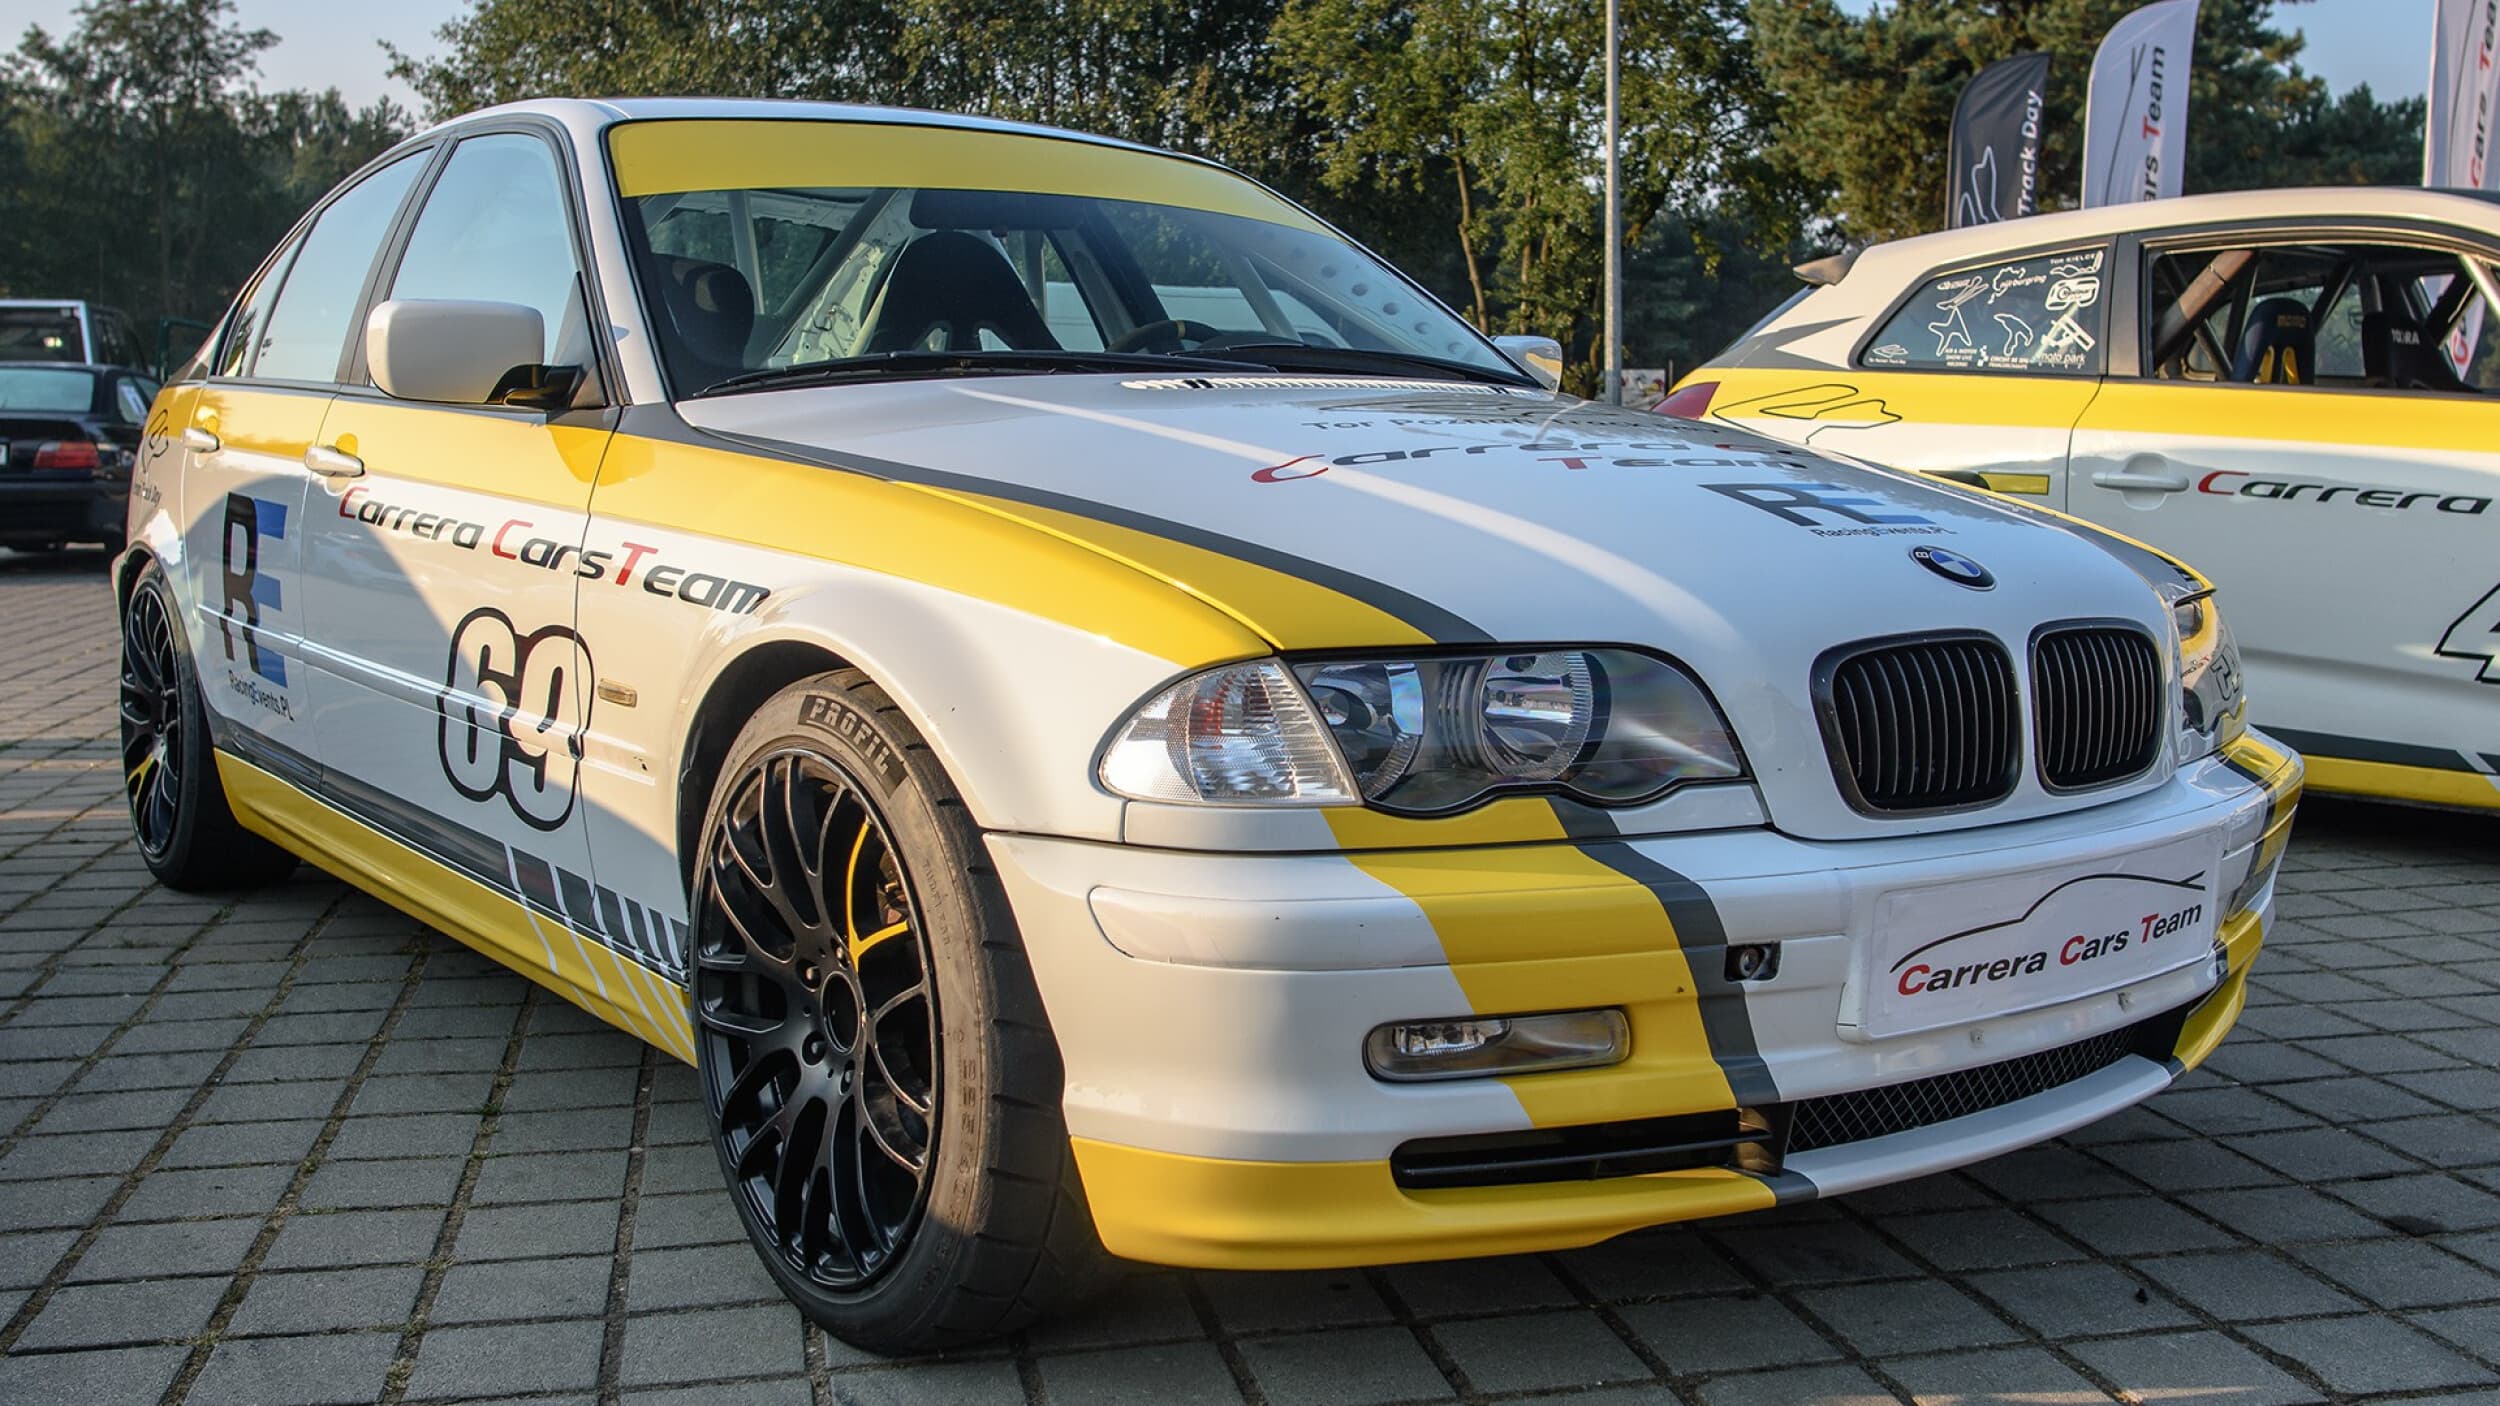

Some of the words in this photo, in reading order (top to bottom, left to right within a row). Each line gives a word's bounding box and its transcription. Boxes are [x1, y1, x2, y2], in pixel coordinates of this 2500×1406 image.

[2479, 0, 2497, 71] Tea
[2022, 89, 2043, 139] Day
[2142, 46, 2166, 139] Team
[2017, 145, 2037, 215] Track
[1302, 421, 1374, 429] Tor
[1251, 443, 1691, 483] Carrera
[1537, 457, 1808, 470] Team
[2198, 470, 2493, 515] Carrera
[1697, 483, 1937, 526] RE
[339, 487, 485, 550] Carrera
[491, 519, 613, 580] Cars
[615, 542, 771, 615] Team
[220, 492, 288, 689] RE
[436, 607, 596, 832] 69
[809, 697, 890, 777] PROFIL
[1897, 950, 2048, 997] Carrera
[2058, 927, 2130, 967] Cars
[2139, 903, 2202, 945] Team
